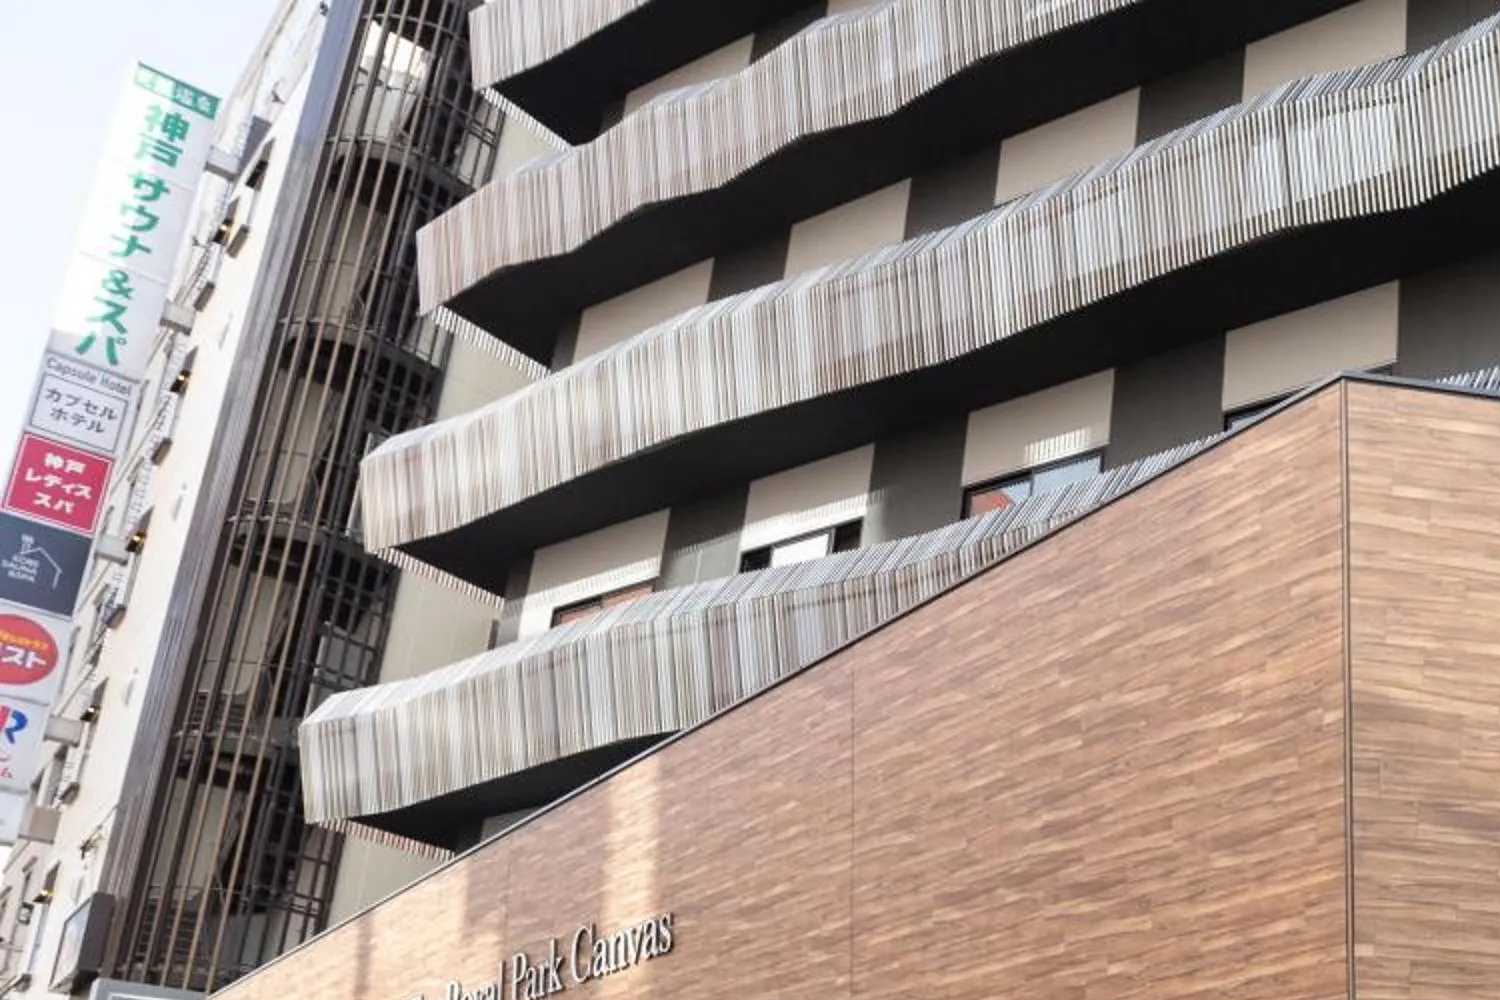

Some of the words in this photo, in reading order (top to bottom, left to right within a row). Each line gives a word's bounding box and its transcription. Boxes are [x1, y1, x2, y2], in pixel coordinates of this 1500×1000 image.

[47, 357, 97, 383] Capsule
[100, 373, 132, 396] Hotel
[49, 408, 105, 433] ホテル
[34, 492, 75, 514] スパ
[0, 644, 47, 669] スト
[570, 911, 675, 984] Canvas
